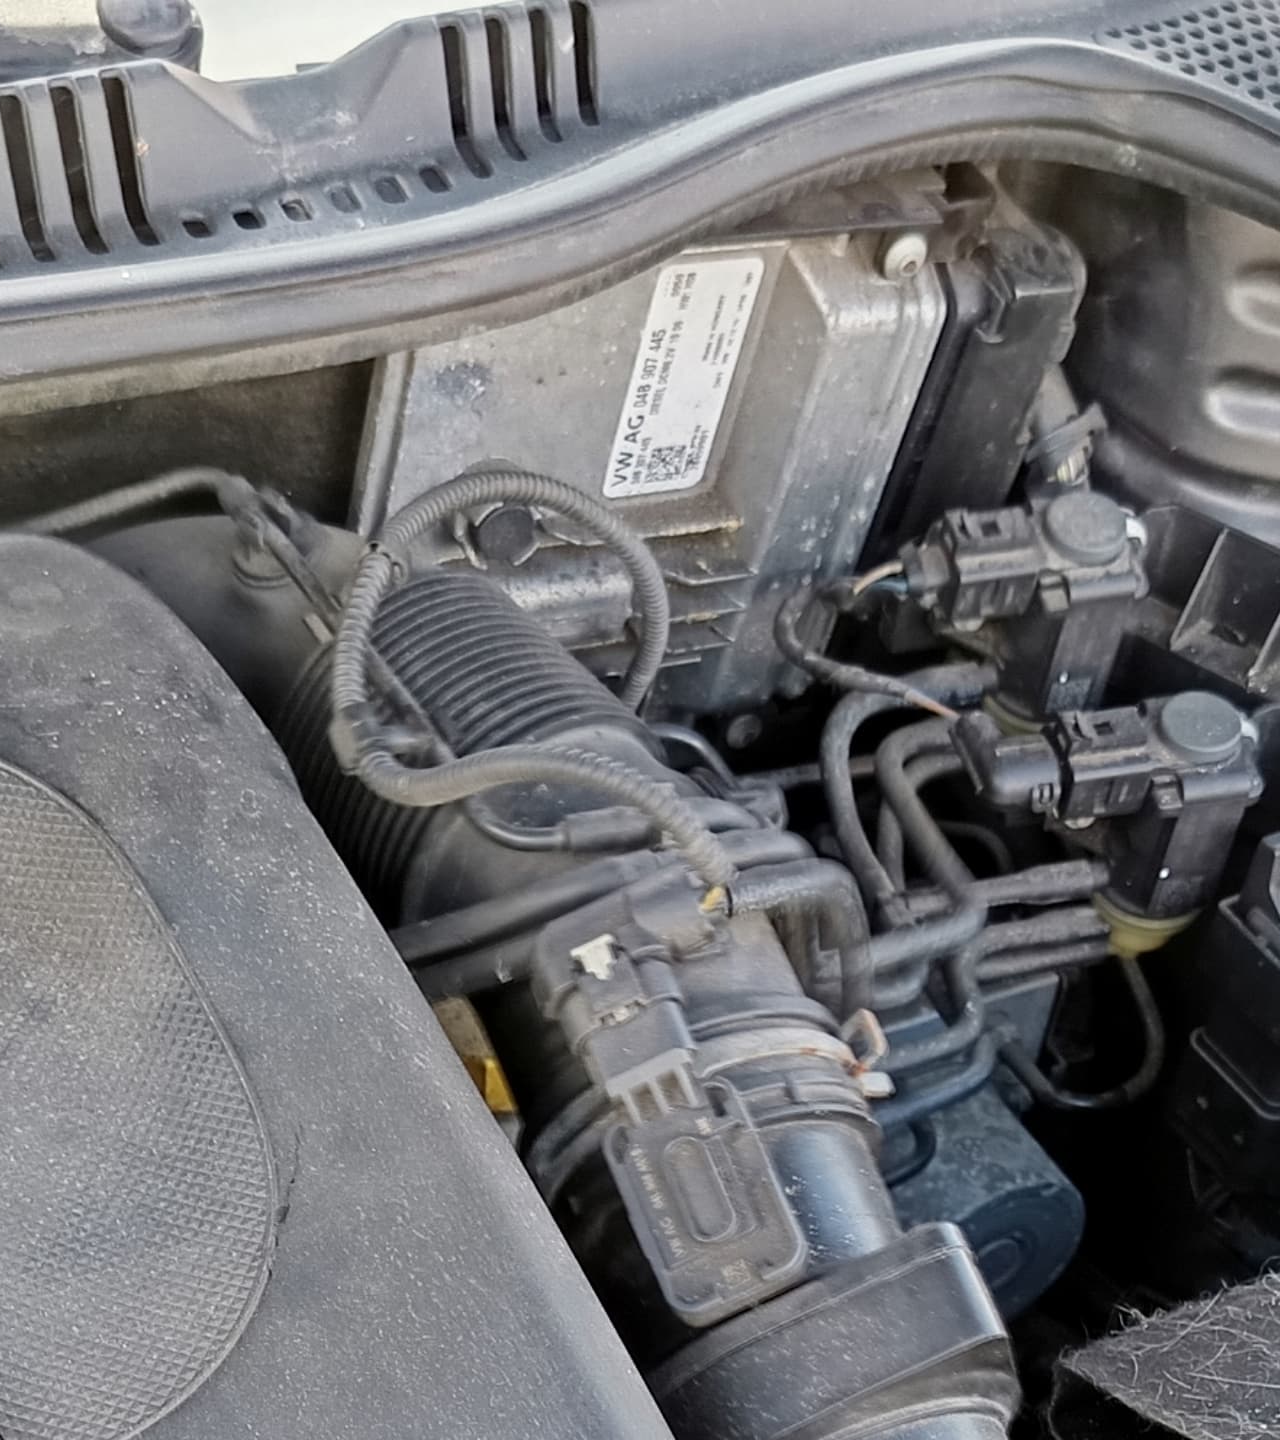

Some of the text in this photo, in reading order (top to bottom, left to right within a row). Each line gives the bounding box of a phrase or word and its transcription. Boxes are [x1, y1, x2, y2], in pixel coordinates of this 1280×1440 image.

[610, 451, 634, 487] VW
[624, 415, 645, 444] AG
[641, 358, 658, 382] 907
[651, 329, 667, 354] 445
